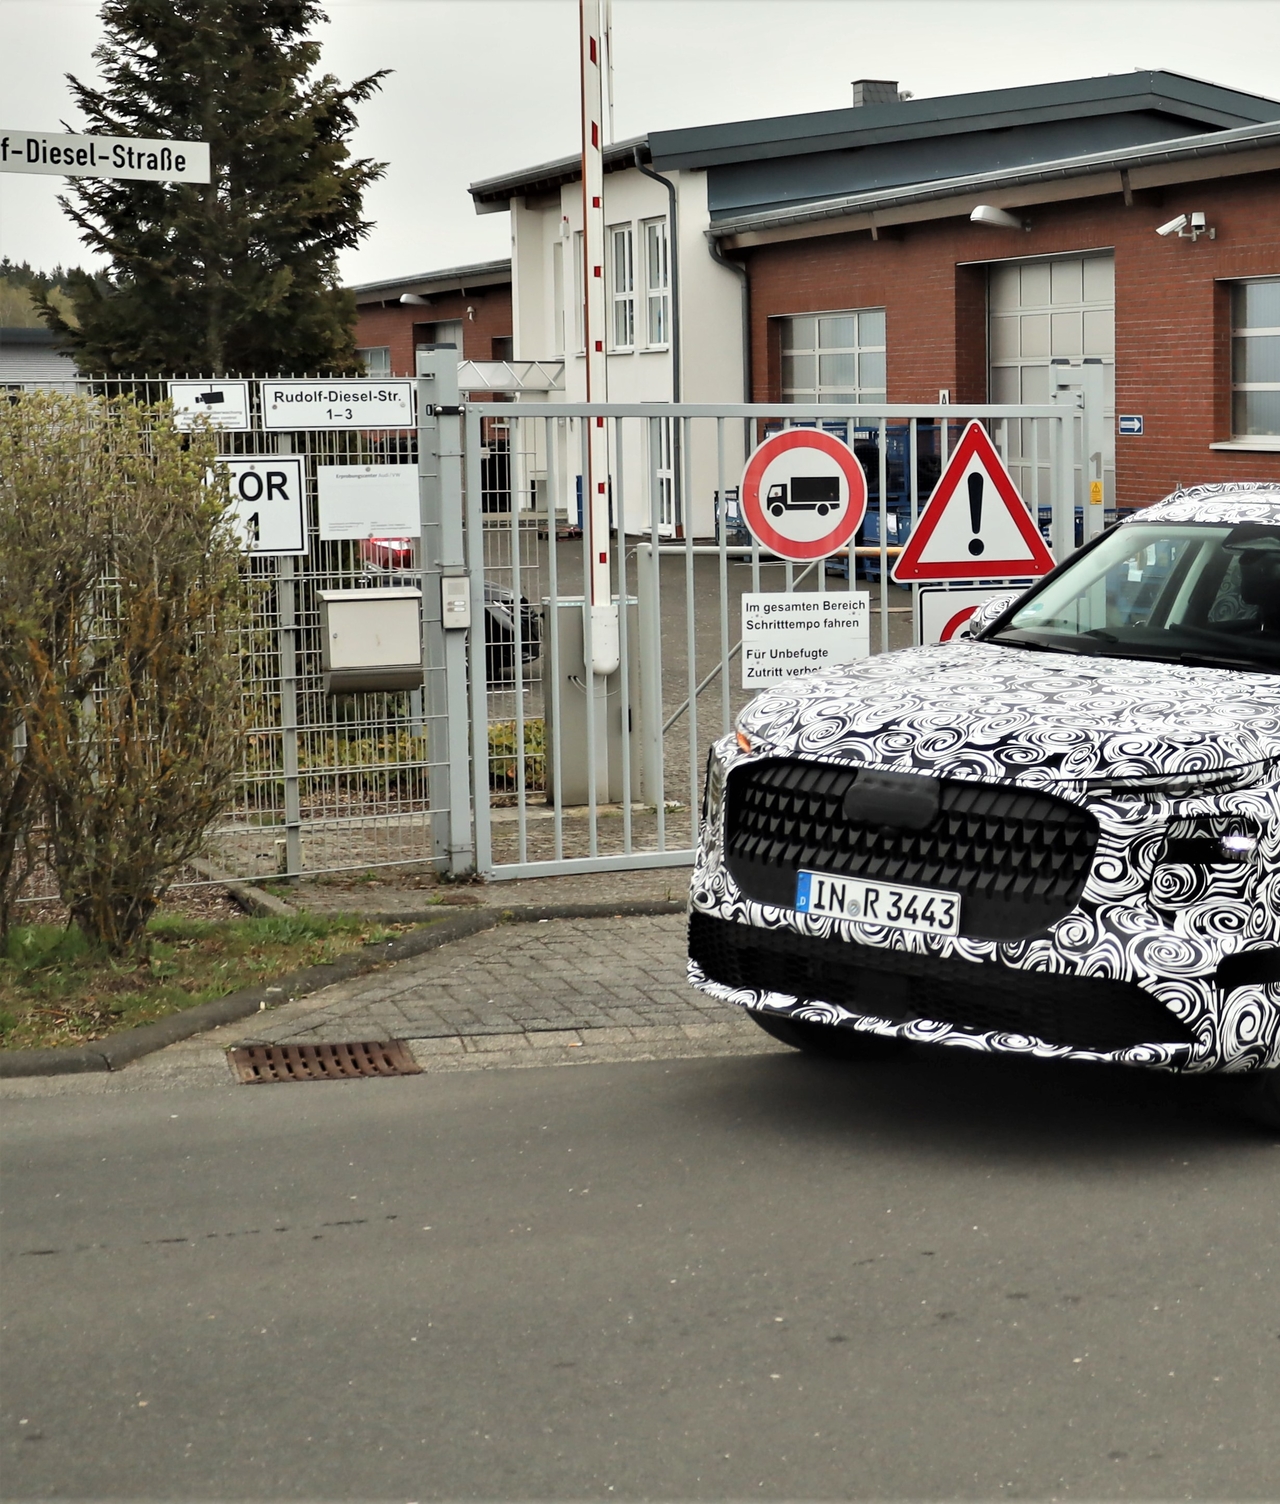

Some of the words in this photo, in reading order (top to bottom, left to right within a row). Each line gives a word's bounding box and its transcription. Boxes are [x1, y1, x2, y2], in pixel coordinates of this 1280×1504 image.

[1, 137, 186, 172] f-Diesel-Straße
[274, 390, 401, 403] Rudolf-Diesel-Str.
[247, 511, 260, 541] 1
[745, 603, 760, 612] Im
[763, 602, 819, 615] gesamten
[823, 600, 866, 611] Bereich
[746, 619, 820, 631] Schritttempo
[823, 618, 859, 628] fahren
[746, 648, 766, 660] Für
[769, 648, 829, 660] Unbefugte
[747, 667, 783, 678] Zutritt
[800, 896, 806, 906] D
[813, 880, 846, 913] IN
[863, 887, 880, 919] R
[886, 891, 955, 929] 3443
